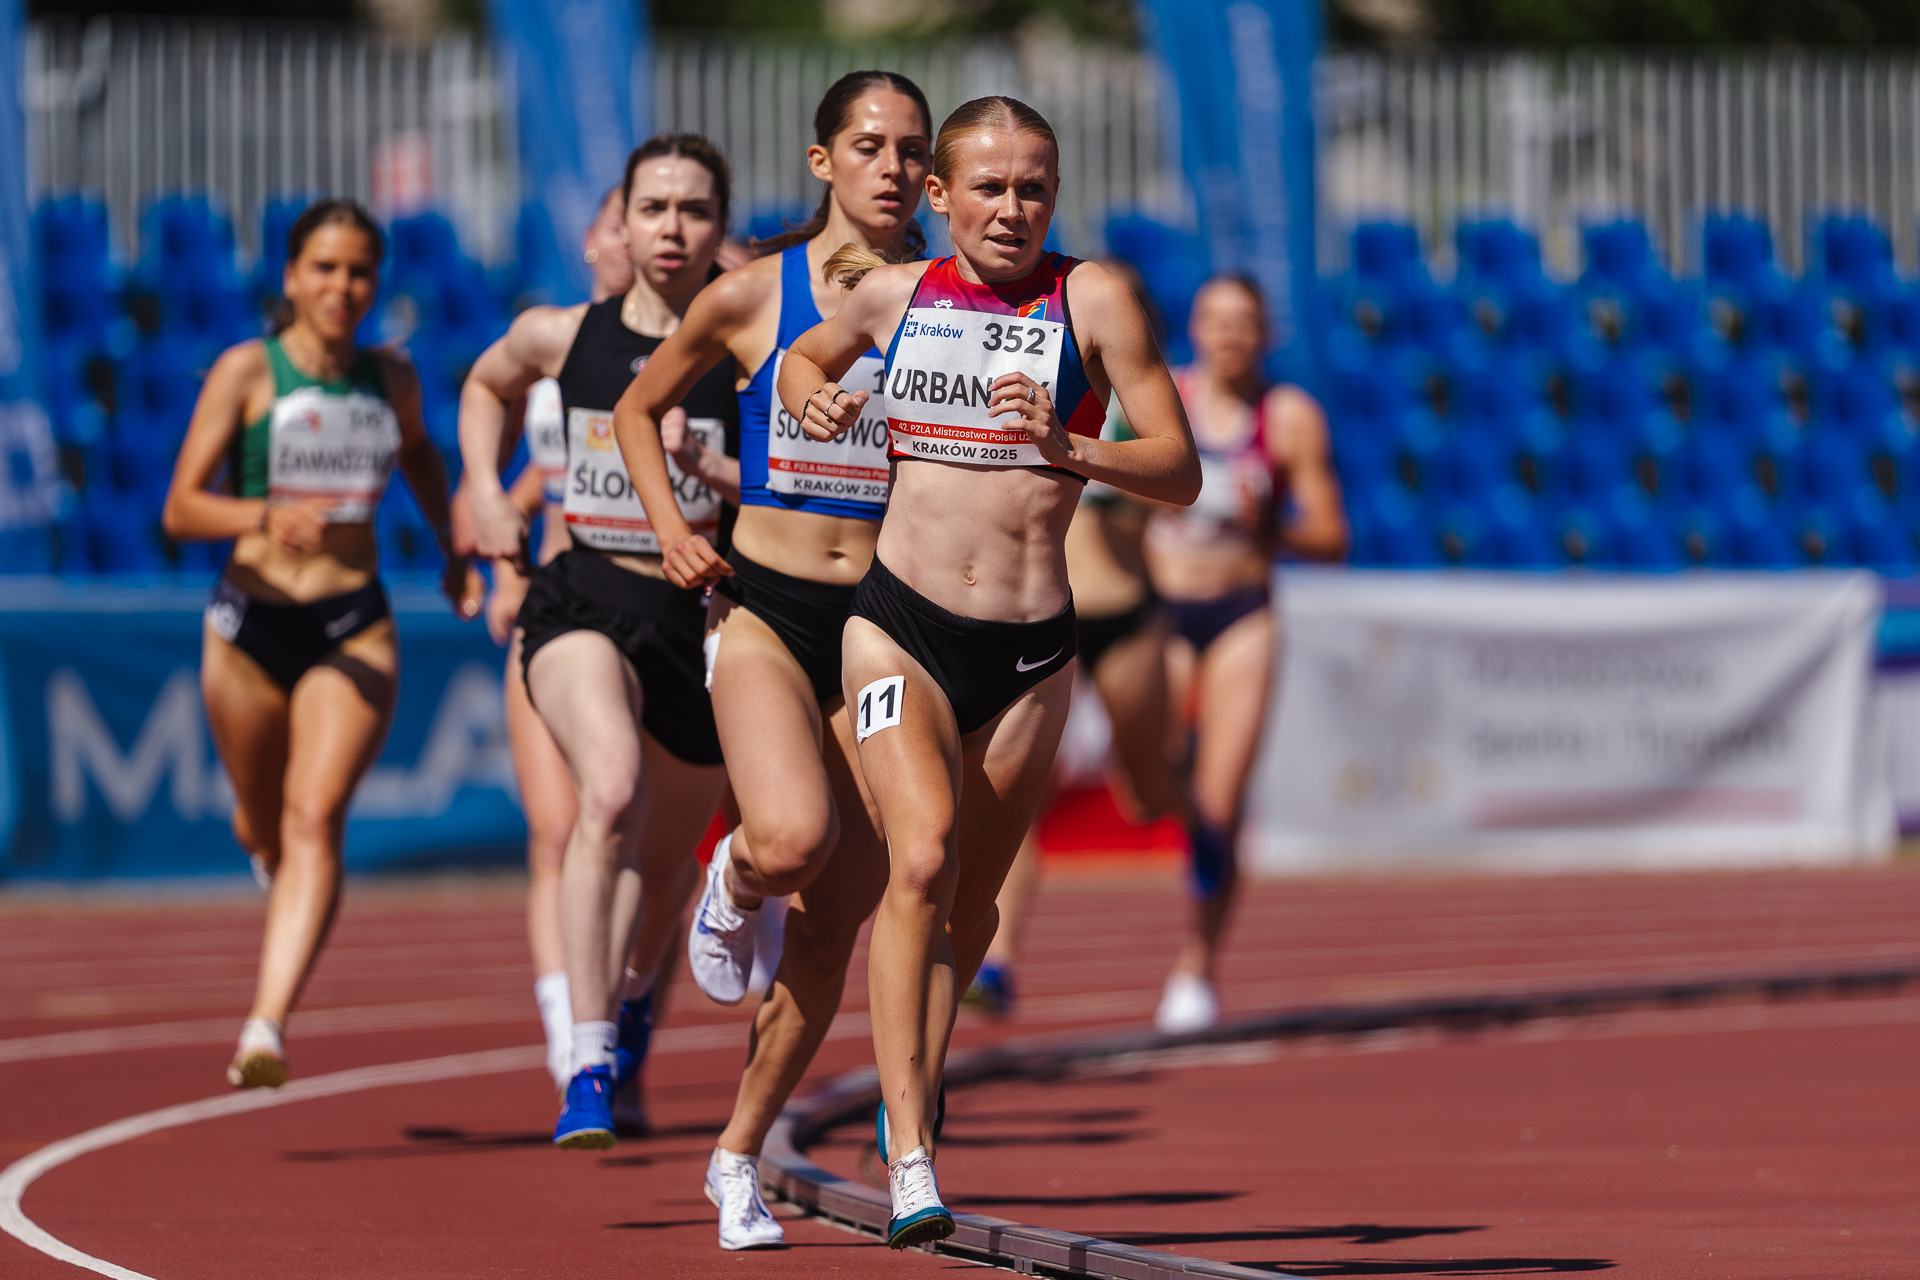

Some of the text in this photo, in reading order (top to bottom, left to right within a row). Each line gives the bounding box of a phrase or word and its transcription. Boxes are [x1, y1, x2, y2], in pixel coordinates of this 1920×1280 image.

[919, 322, 964, 339] Kraków
[982, 322, 1046, 356] 352
[891, 368, 1050, 410] URBAN
[898, 422, 909, 432] 42.
[910, 423, 931, 435] PZLA
[933, 427, 988, 440] Mistrzostwa
[989, 432, 1017, 442] Polski
[912, 440, 1018, 460] KRAKÓW 2025
[573, 460, 713, 503] ŚLOKA
[793, 478, 860, 495] KRAKÓW
[860, 684, 896, 730] 11
